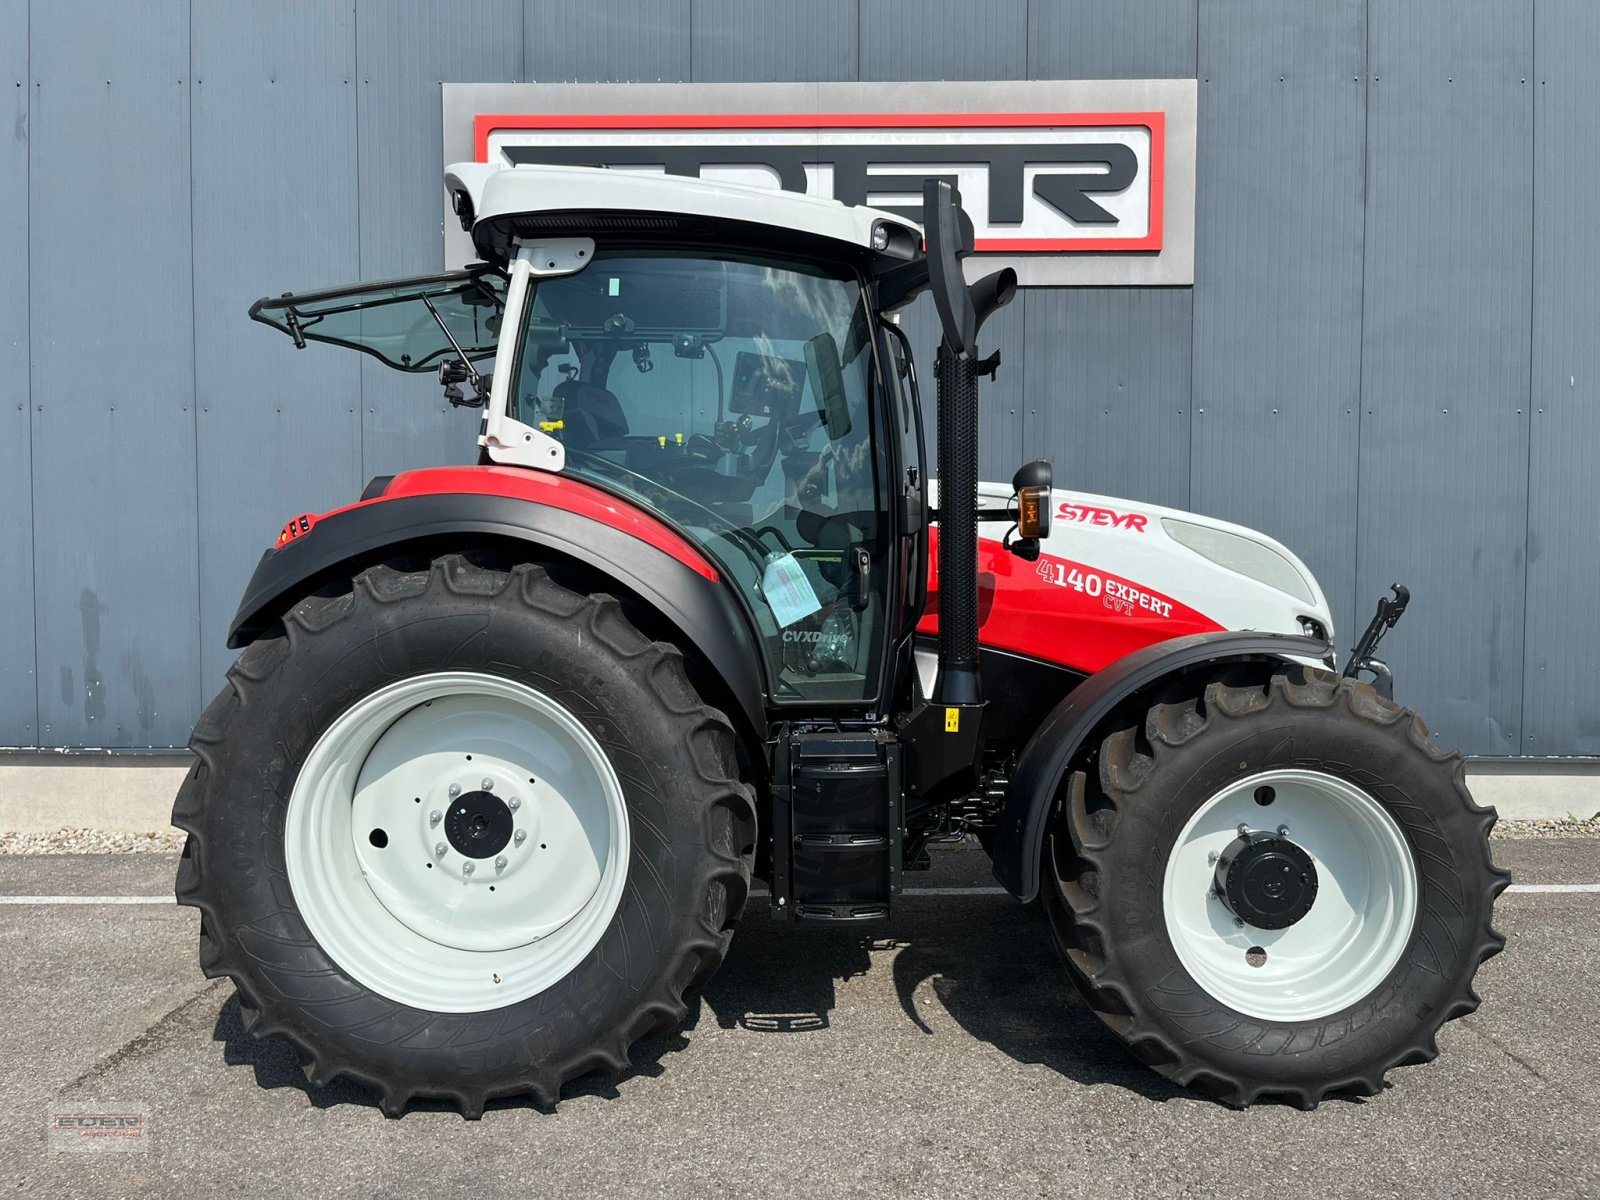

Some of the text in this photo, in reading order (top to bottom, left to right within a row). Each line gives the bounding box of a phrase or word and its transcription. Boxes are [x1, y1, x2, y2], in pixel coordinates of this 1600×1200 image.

[1054, 502, 1148, 533] STEYR
[1036, 559, 1173, 618] 4140 EXPERT
[1103, 594, 1135, 616] CVT
[782, 630, 849, 643] CVXDrive
